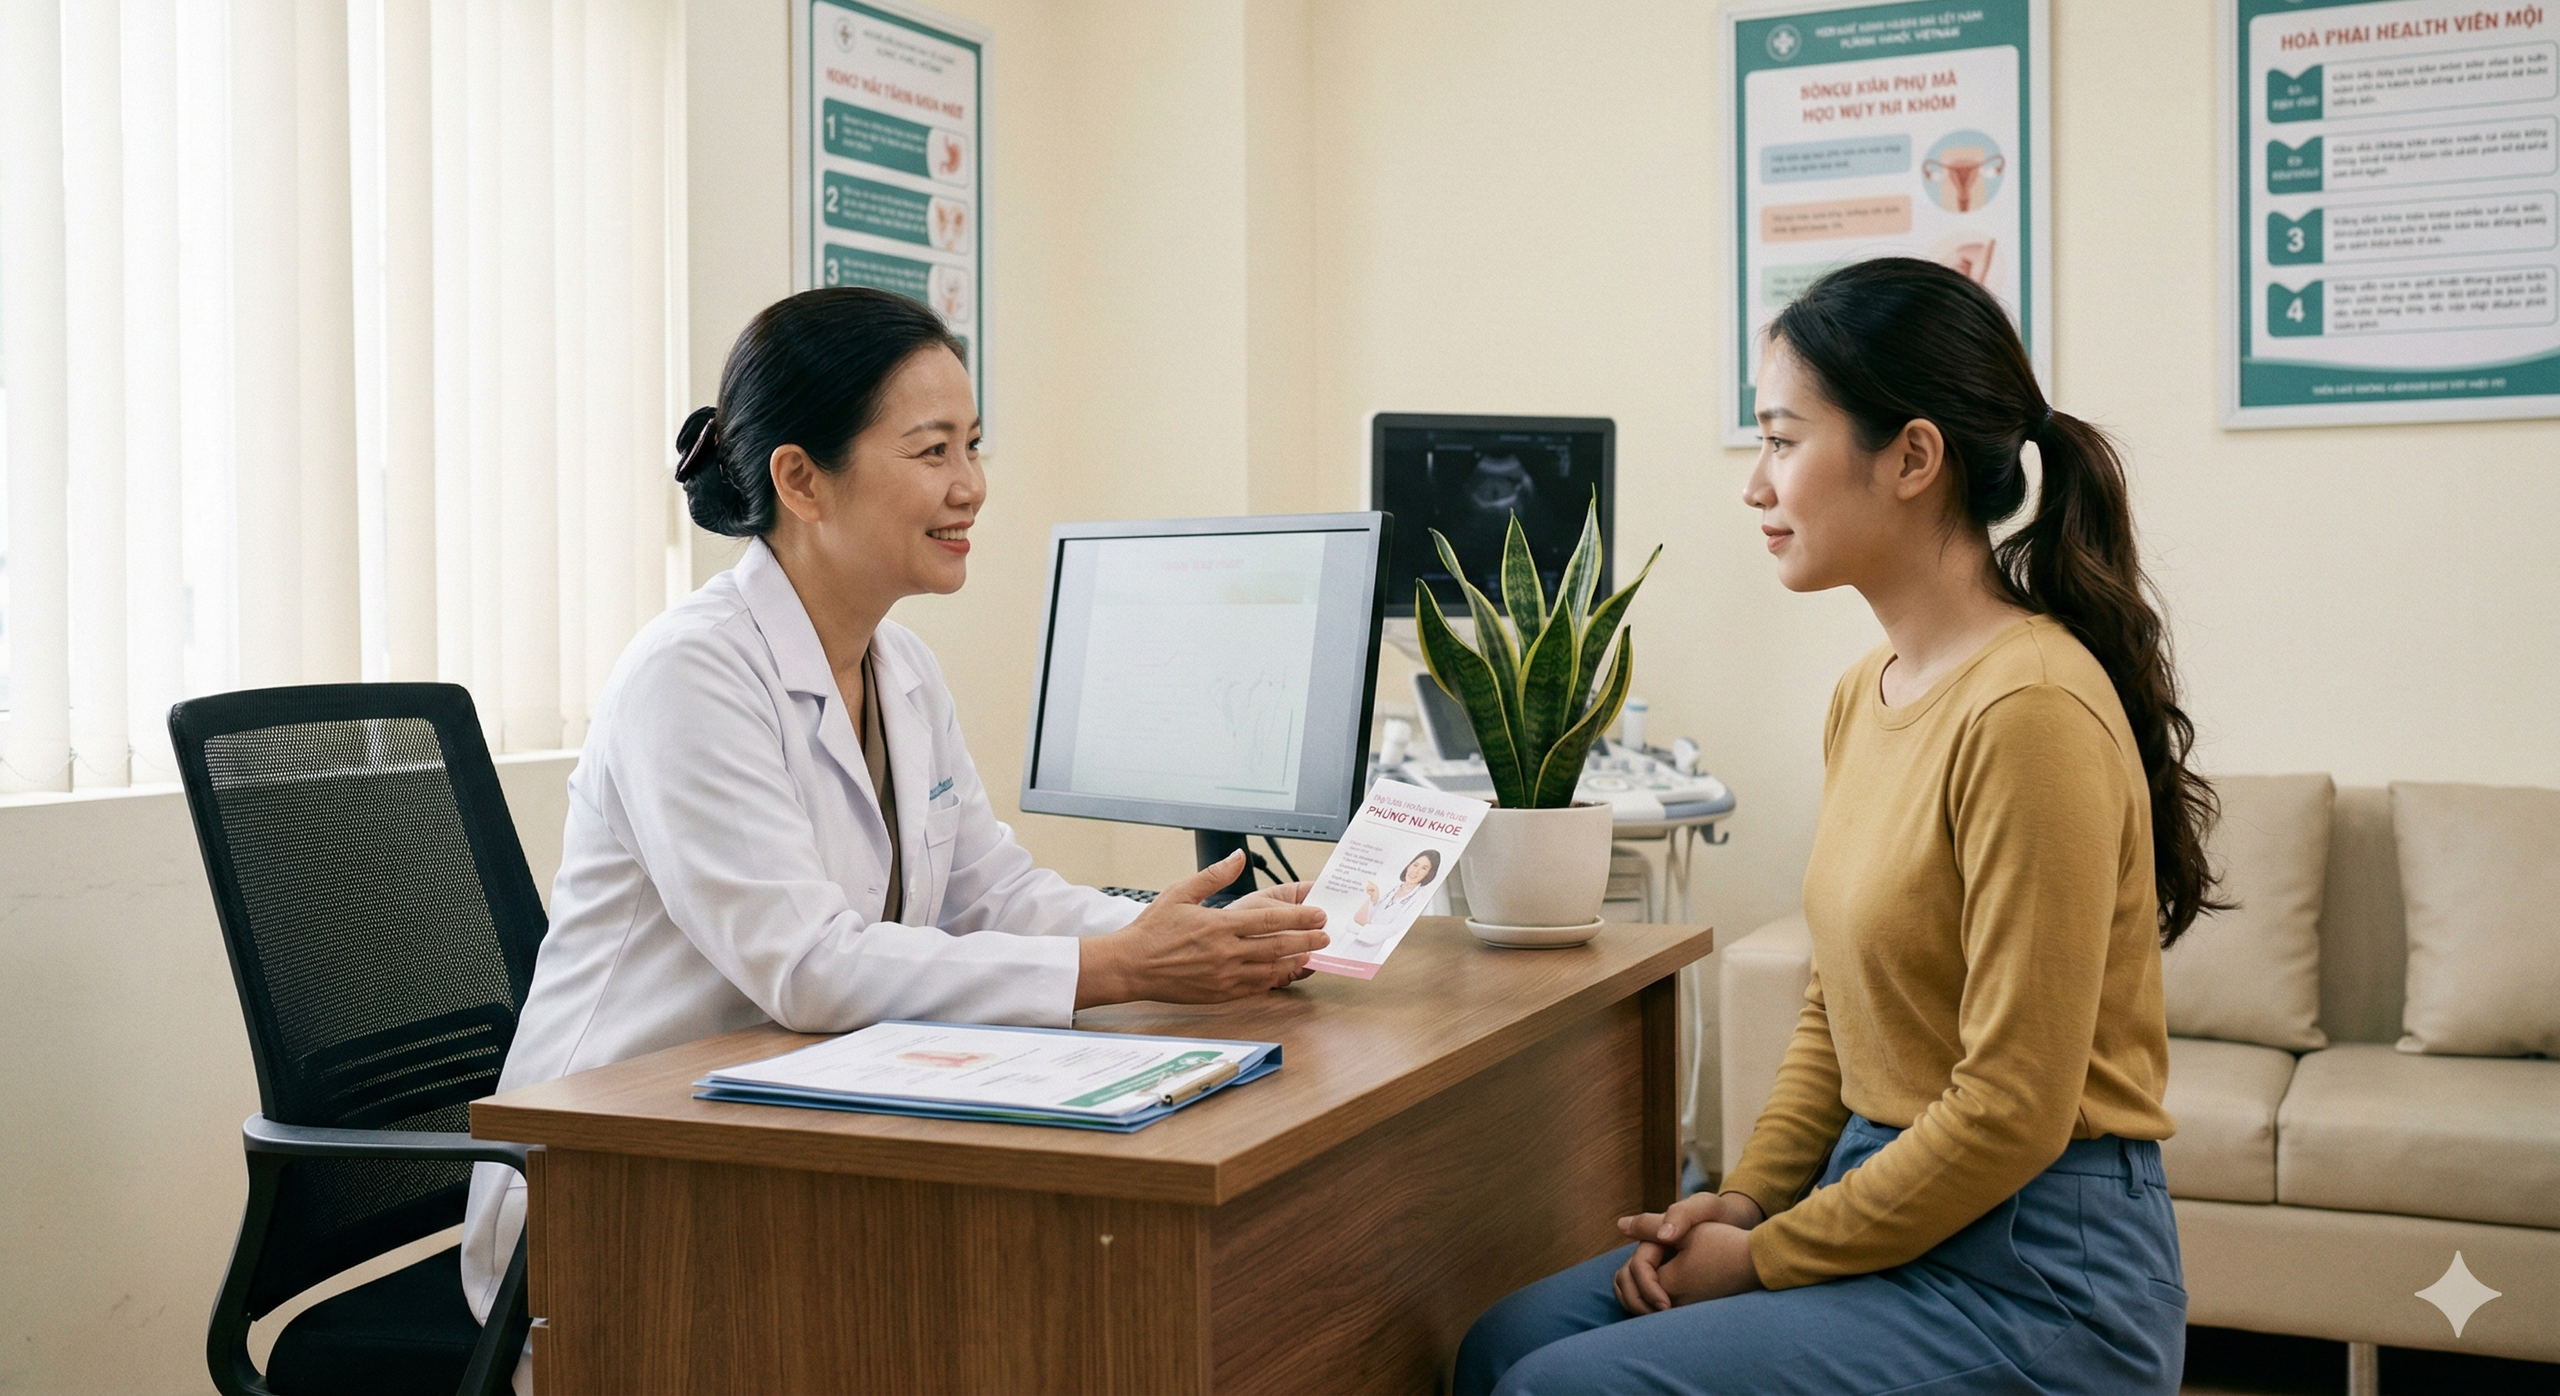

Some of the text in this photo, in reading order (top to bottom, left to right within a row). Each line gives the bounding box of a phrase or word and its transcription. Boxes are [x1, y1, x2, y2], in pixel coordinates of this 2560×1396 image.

[2376, 17, 2448, 41] HEALTH
[826, 116, 836, 141] 1
[826, 185, 839, 214] 2
[2286, 226, 2306, 253] 3
[826, 257, 840, 286] 3
[2286, 298, 2305, 323] 4
